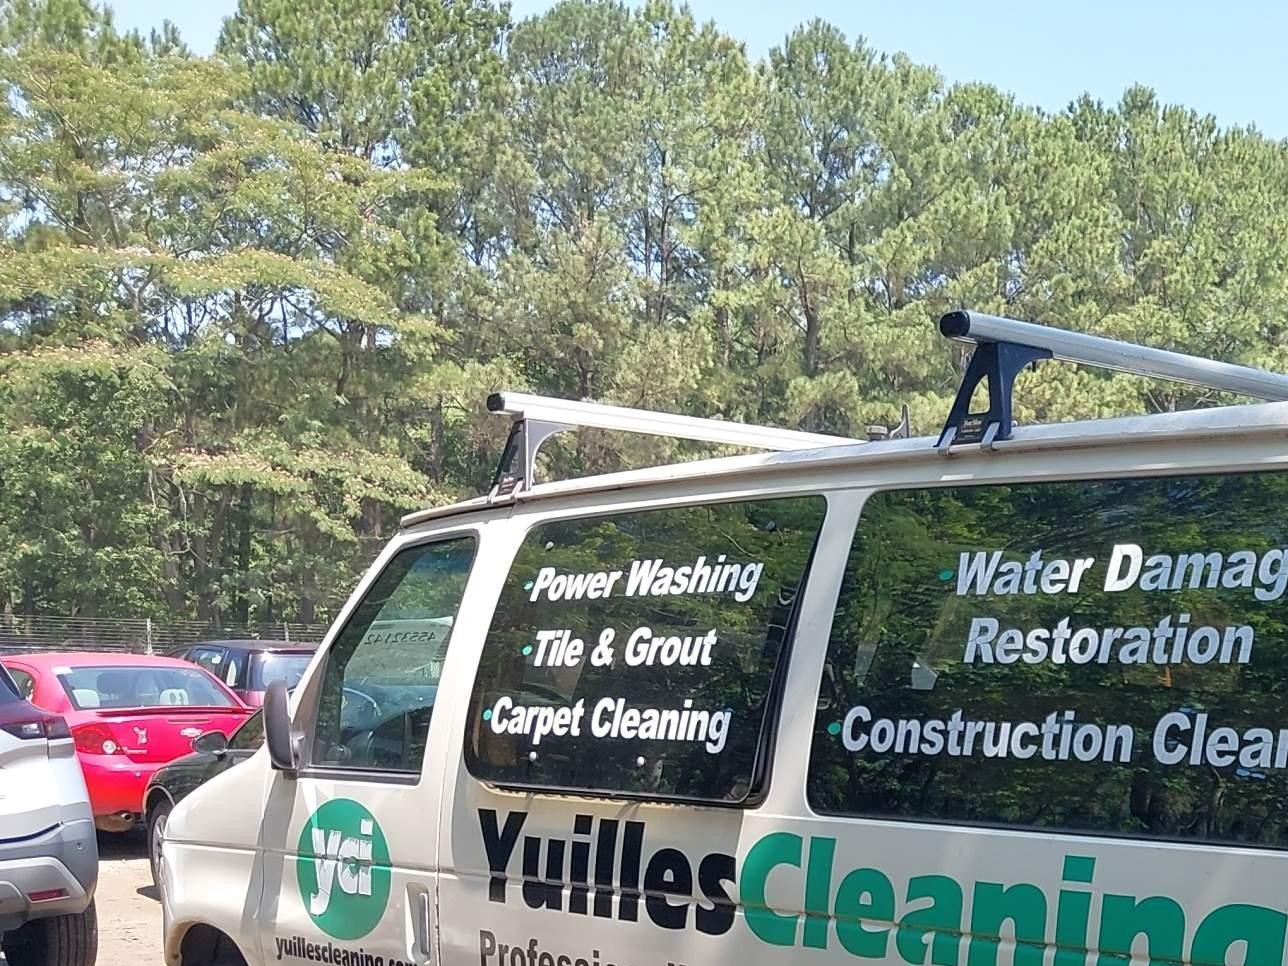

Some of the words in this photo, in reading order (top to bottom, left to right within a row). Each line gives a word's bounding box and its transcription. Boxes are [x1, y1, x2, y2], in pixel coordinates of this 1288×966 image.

[530, 567, 622, 601] Power
[625, 554, 763, 602] Washing
[955, 549, 1095, 595] Water
[533, 629, 584, 666] Tile
[590, 627, 616, 666] &
[625, 626, 718, 666] Grout
[964, 614, 1254, 665] Restoration
[490, 696, 585, 745] Carpet
[591, 697, 732, 754] Cleaning
[841, 705, 1135, 763] Construction
[310, 818, 374, 917] yci
